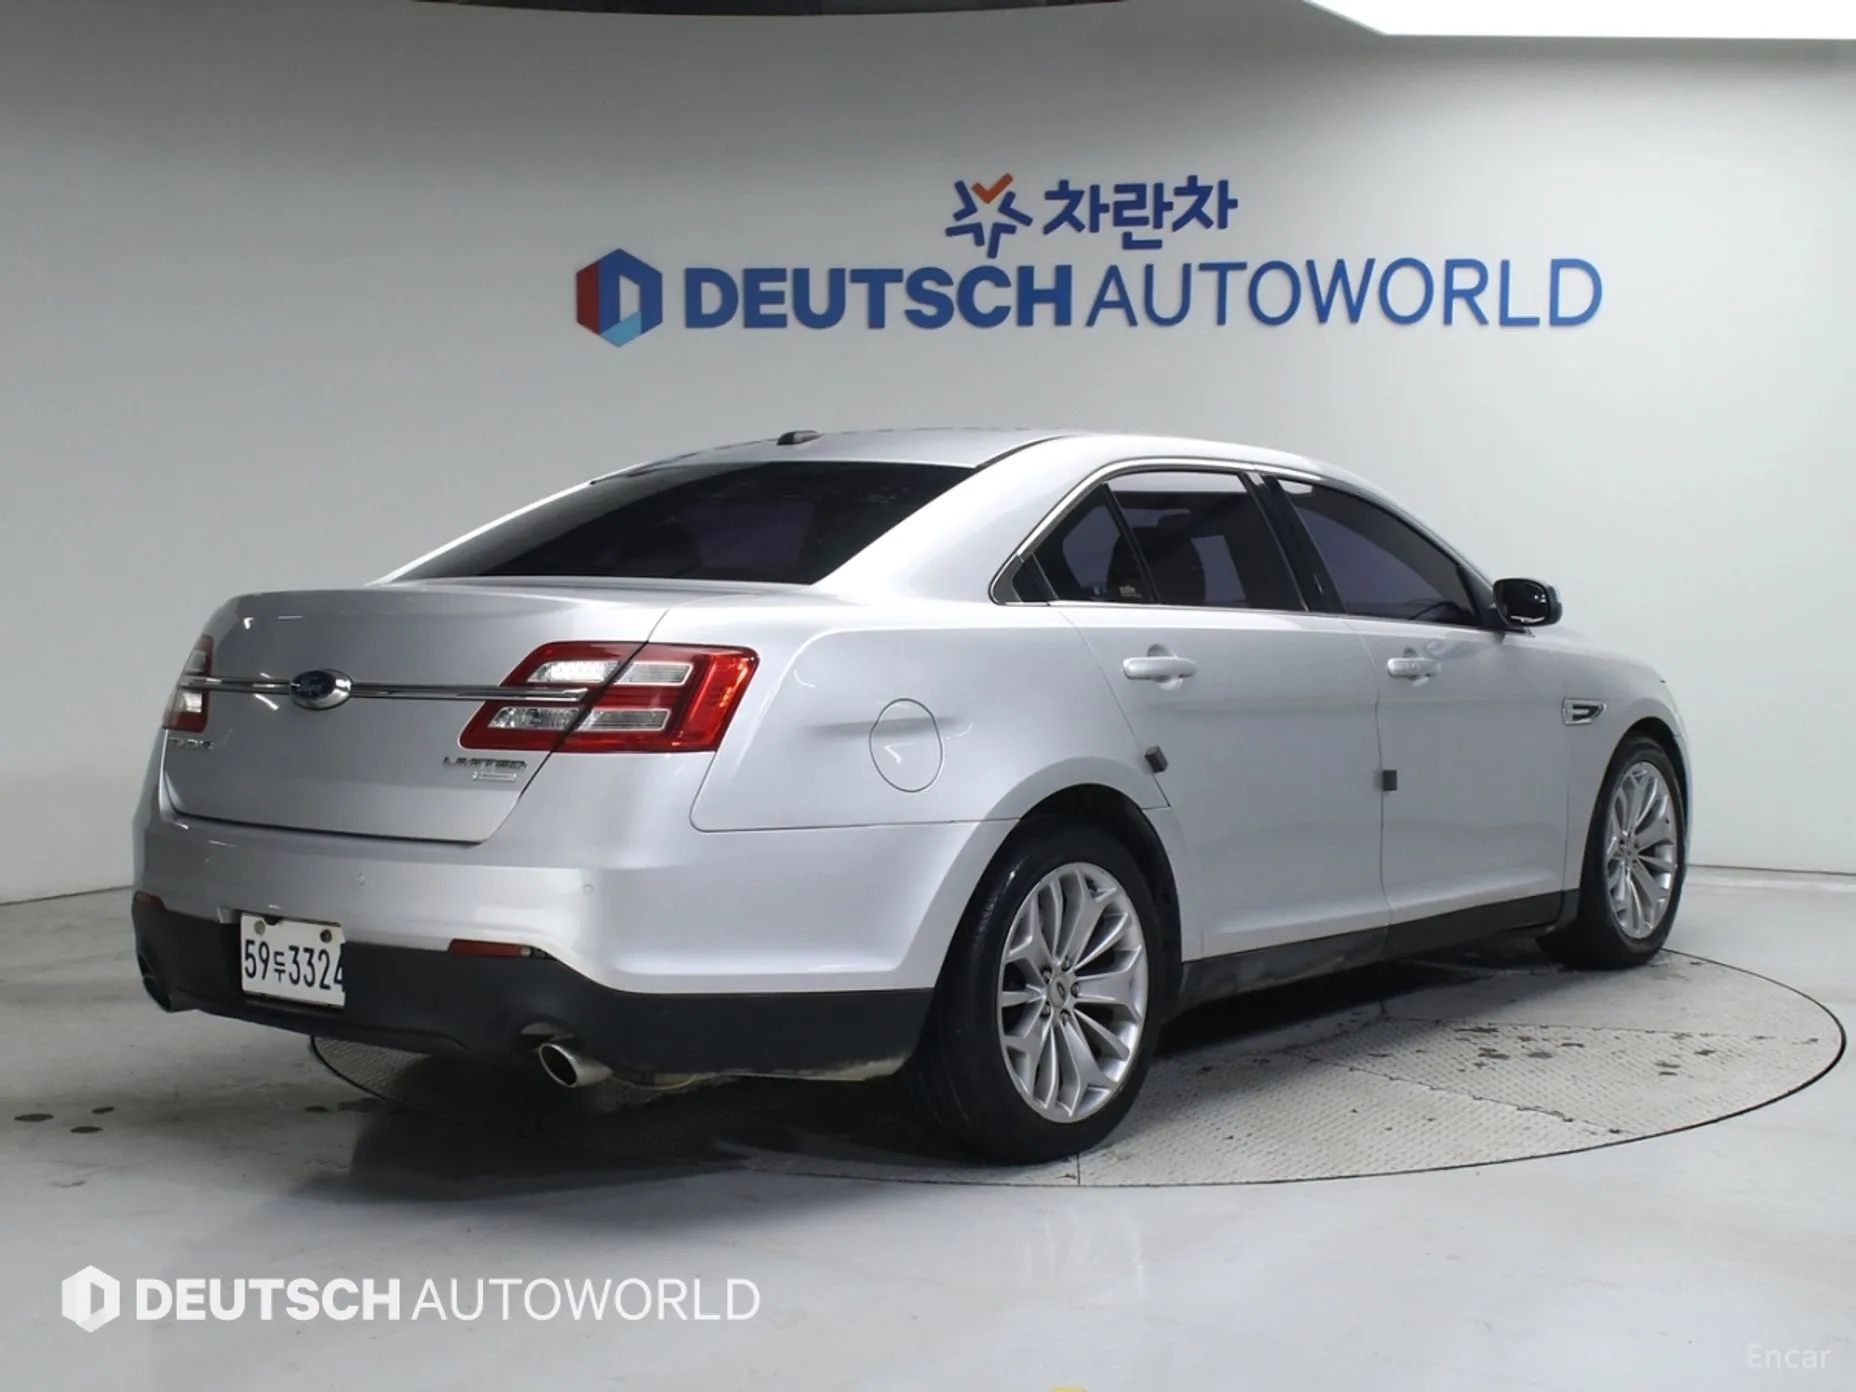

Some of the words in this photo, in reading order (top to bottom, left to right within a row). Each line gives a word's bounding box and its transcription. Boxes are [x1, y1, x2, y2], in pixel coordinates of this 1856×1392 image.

[1043, 175, 1238, 250] 차란차
[685, 263, 1073, 329] DEUTSCH
[1086, 257, 1603, 328] AUTOWORLD
